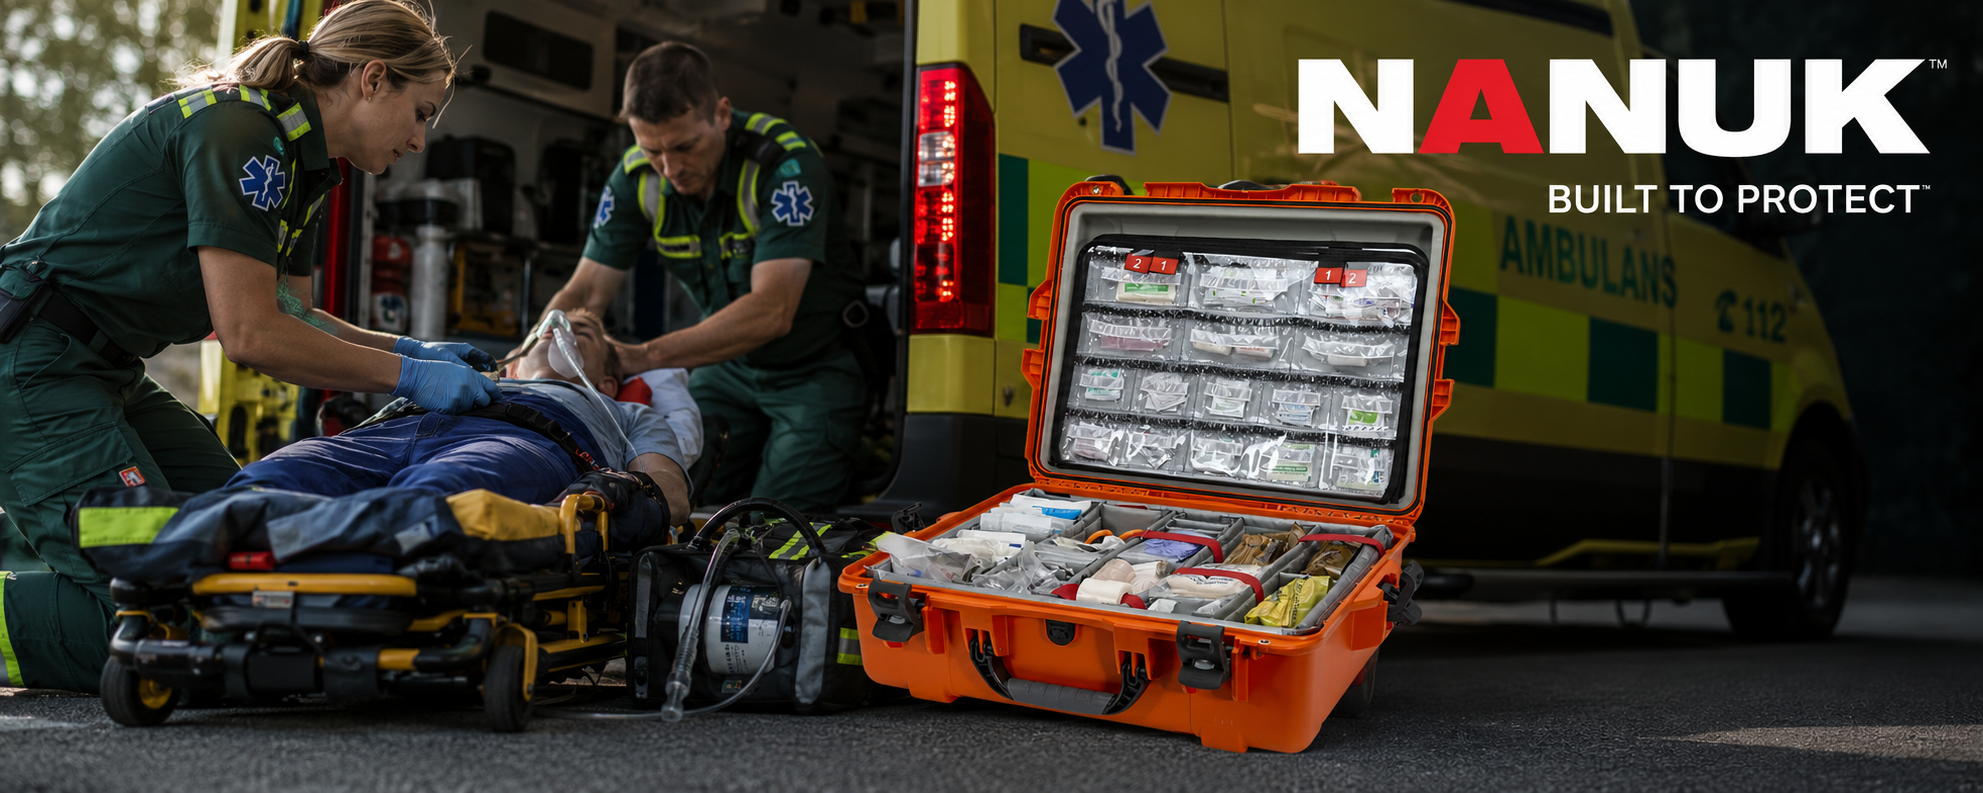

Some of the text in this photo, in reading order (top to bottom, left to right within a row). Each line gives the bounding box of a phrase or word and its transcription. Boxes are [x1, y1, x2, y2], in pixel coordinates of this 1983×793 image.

[1133, 258, 1141, 269] 2
[1161, 260, 1167, 271] 1
[1500, 215, 1678, 309] AMBULANS
[1325, 270, 1331, 281] 1
[1348, 273, 1356, 284] 2
[1742, 296, 1788, 344] 112
